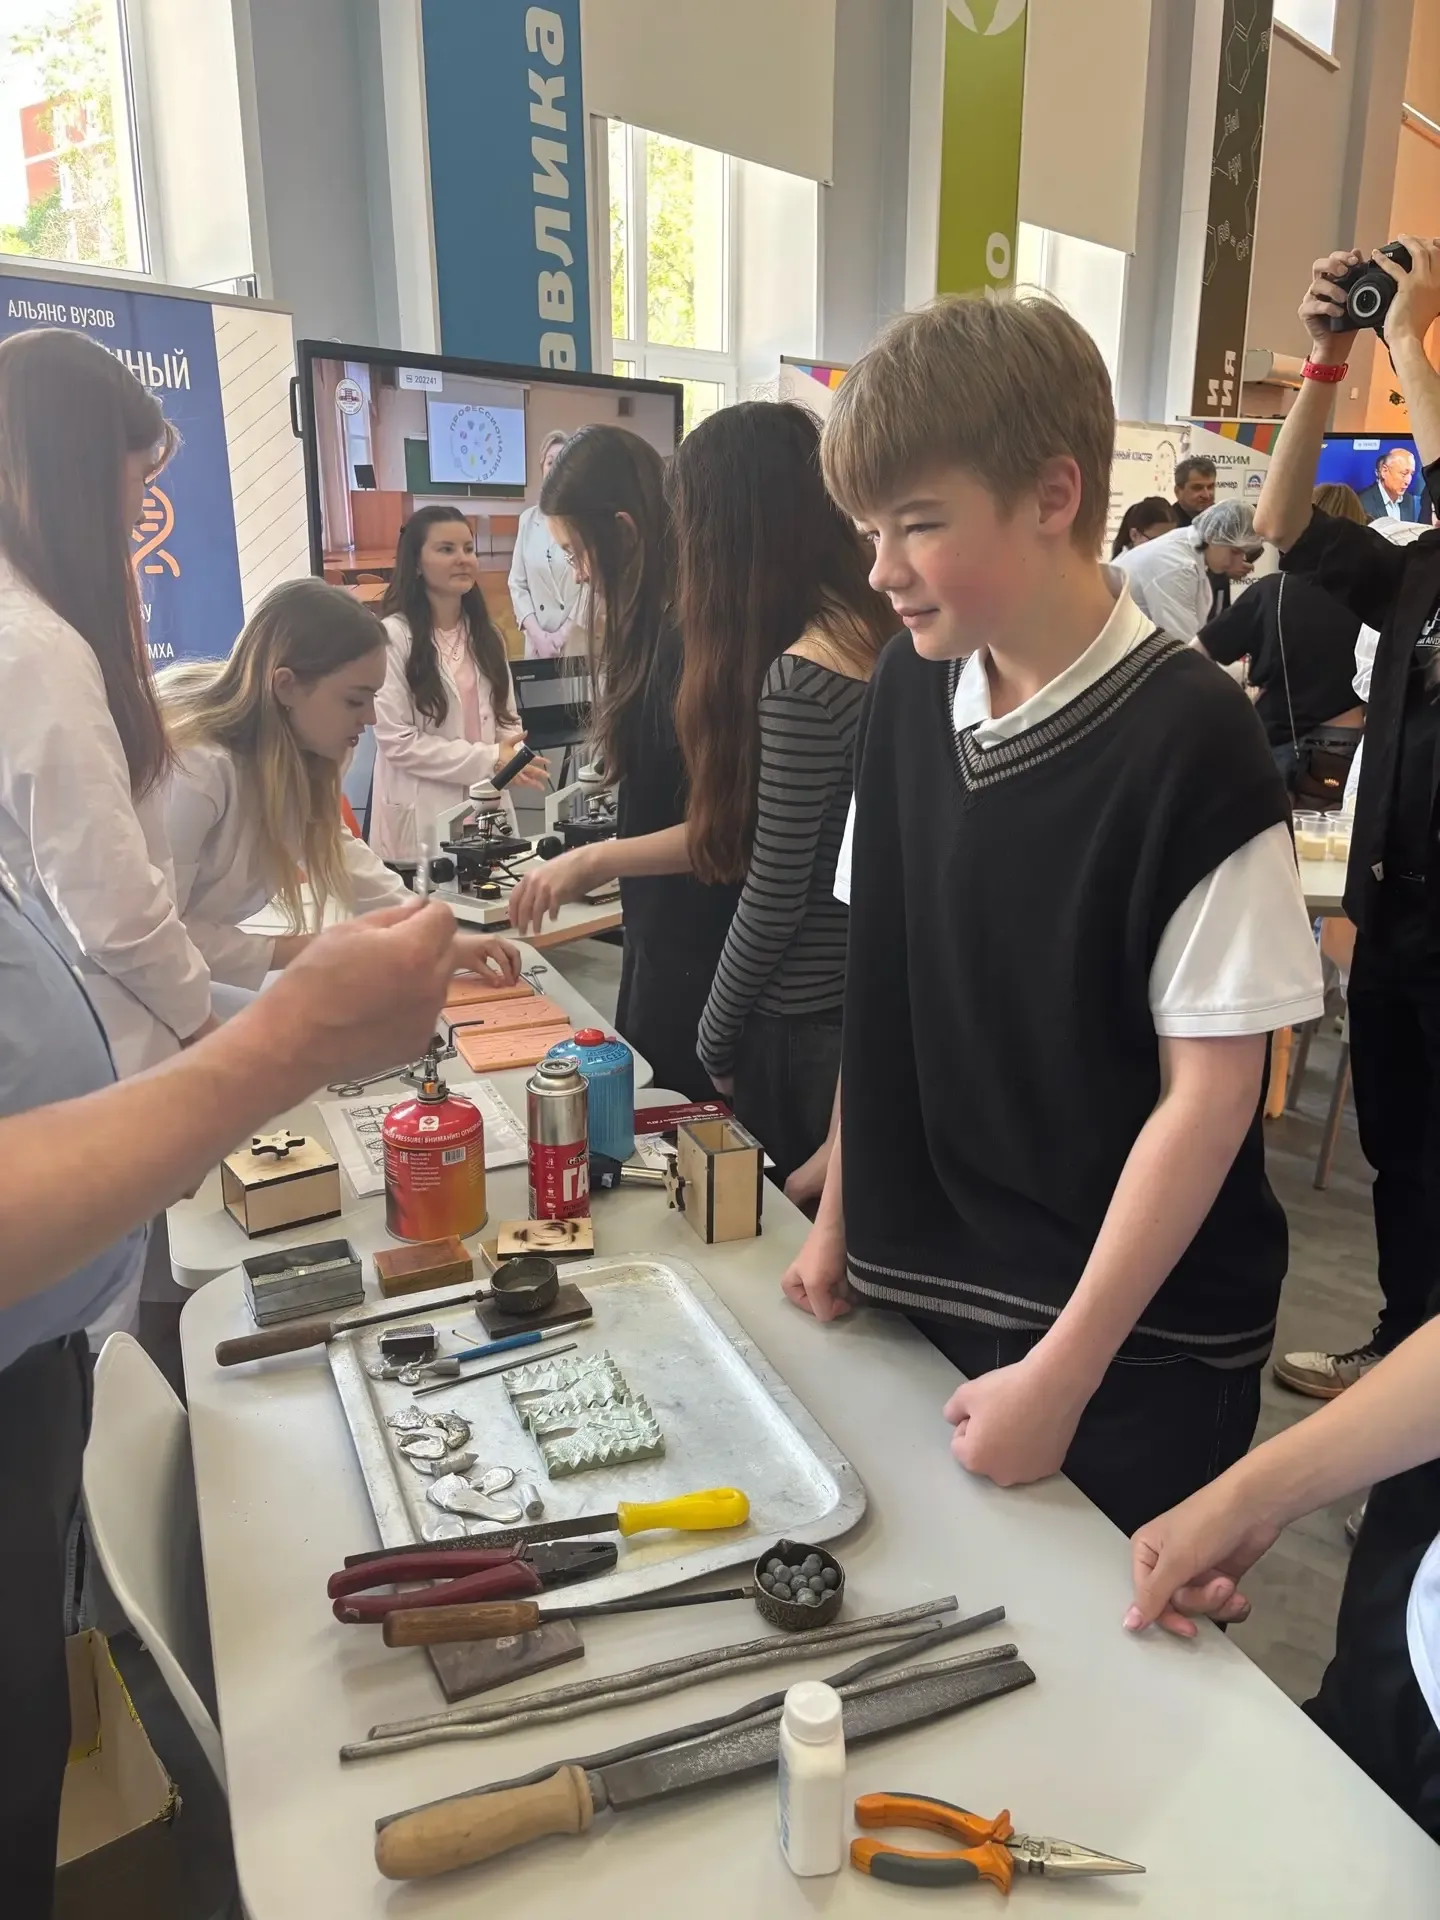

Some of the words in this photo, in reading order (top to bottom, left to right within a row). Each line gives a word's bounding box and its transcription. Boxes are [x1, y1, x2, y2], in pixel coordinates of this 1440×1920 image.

[8, 299, 67, 323] АЛЬЯНС
[70, 306, 116, 328] ВУЗОВ
[414, 375, 438, 385] 202241
[145, 642, 175, 659] МХА
